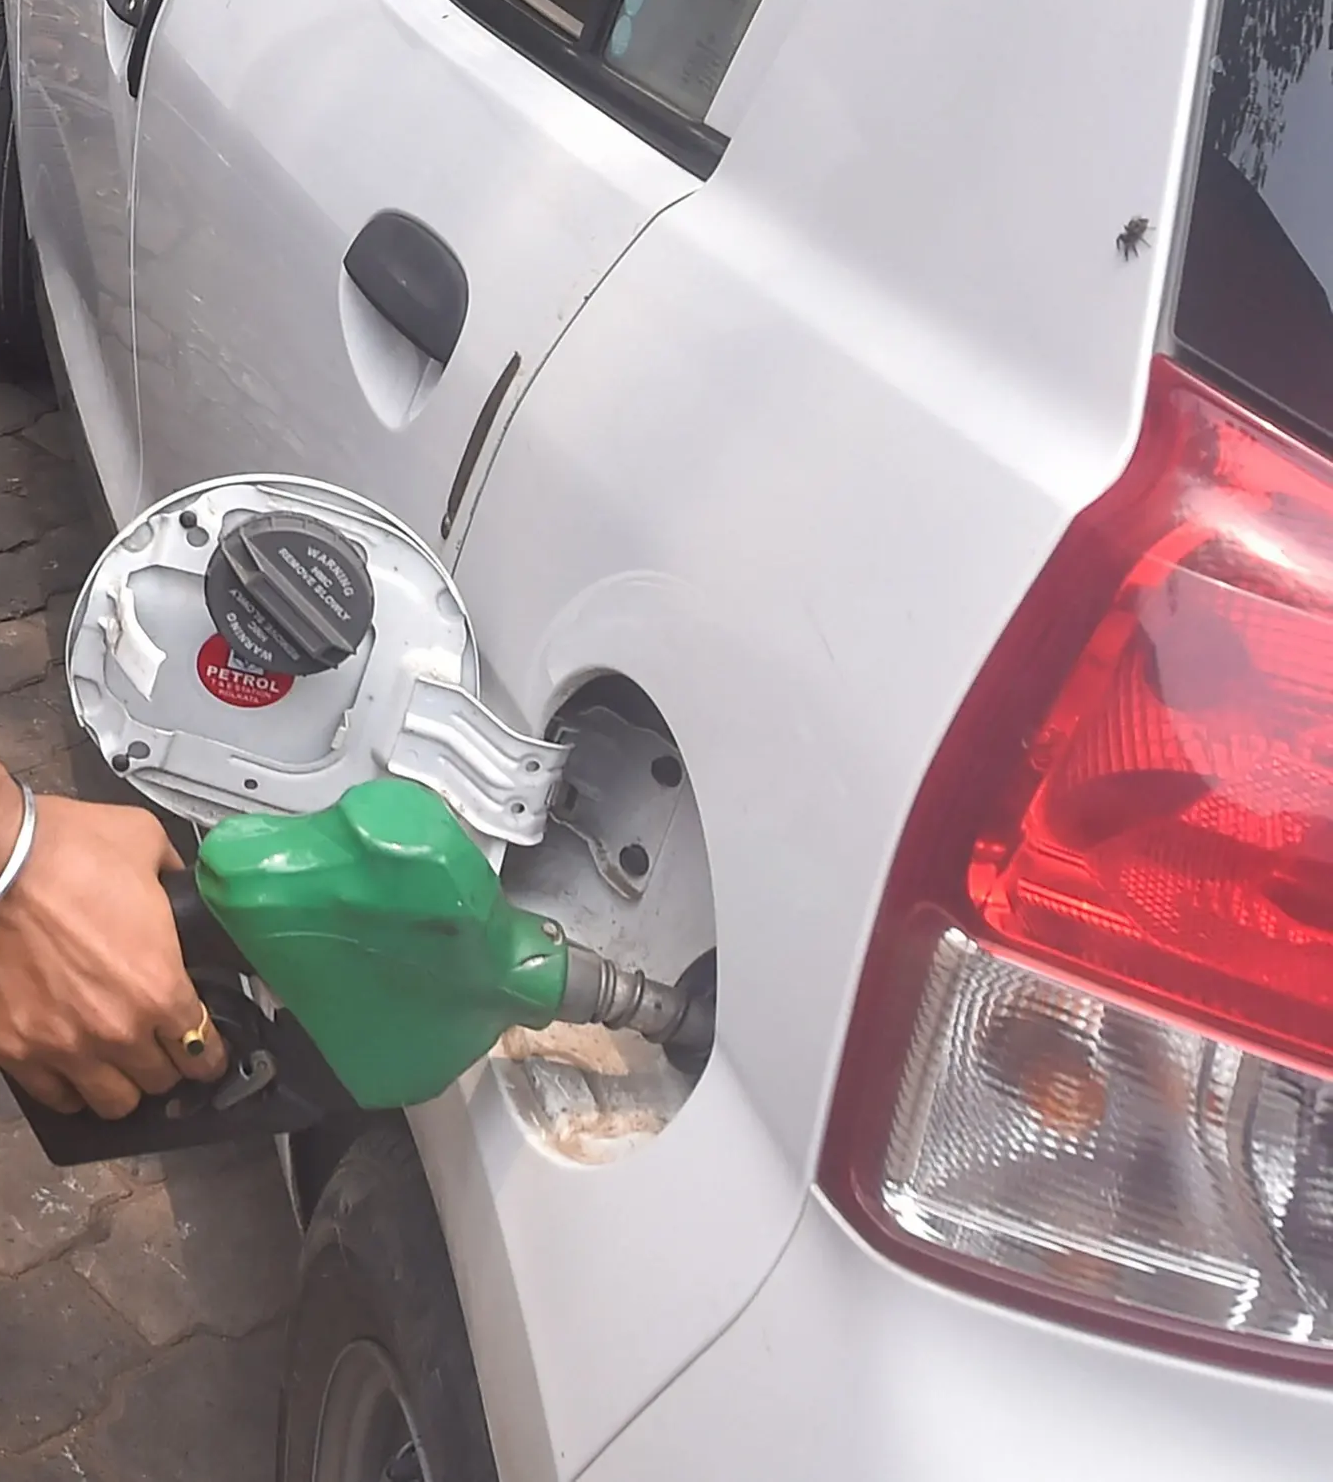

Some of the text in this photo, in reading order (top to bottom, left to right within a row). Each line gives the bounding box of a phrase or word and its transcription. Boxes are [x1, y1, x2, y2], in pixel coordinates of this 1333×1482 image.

[278, 548, 351, 622] REMOVE SLOWLY
[307, 546, 354, 598] WARNING
[226, 612, 273, 662] WARNING
[206, 665, 279, 694] PETROL
